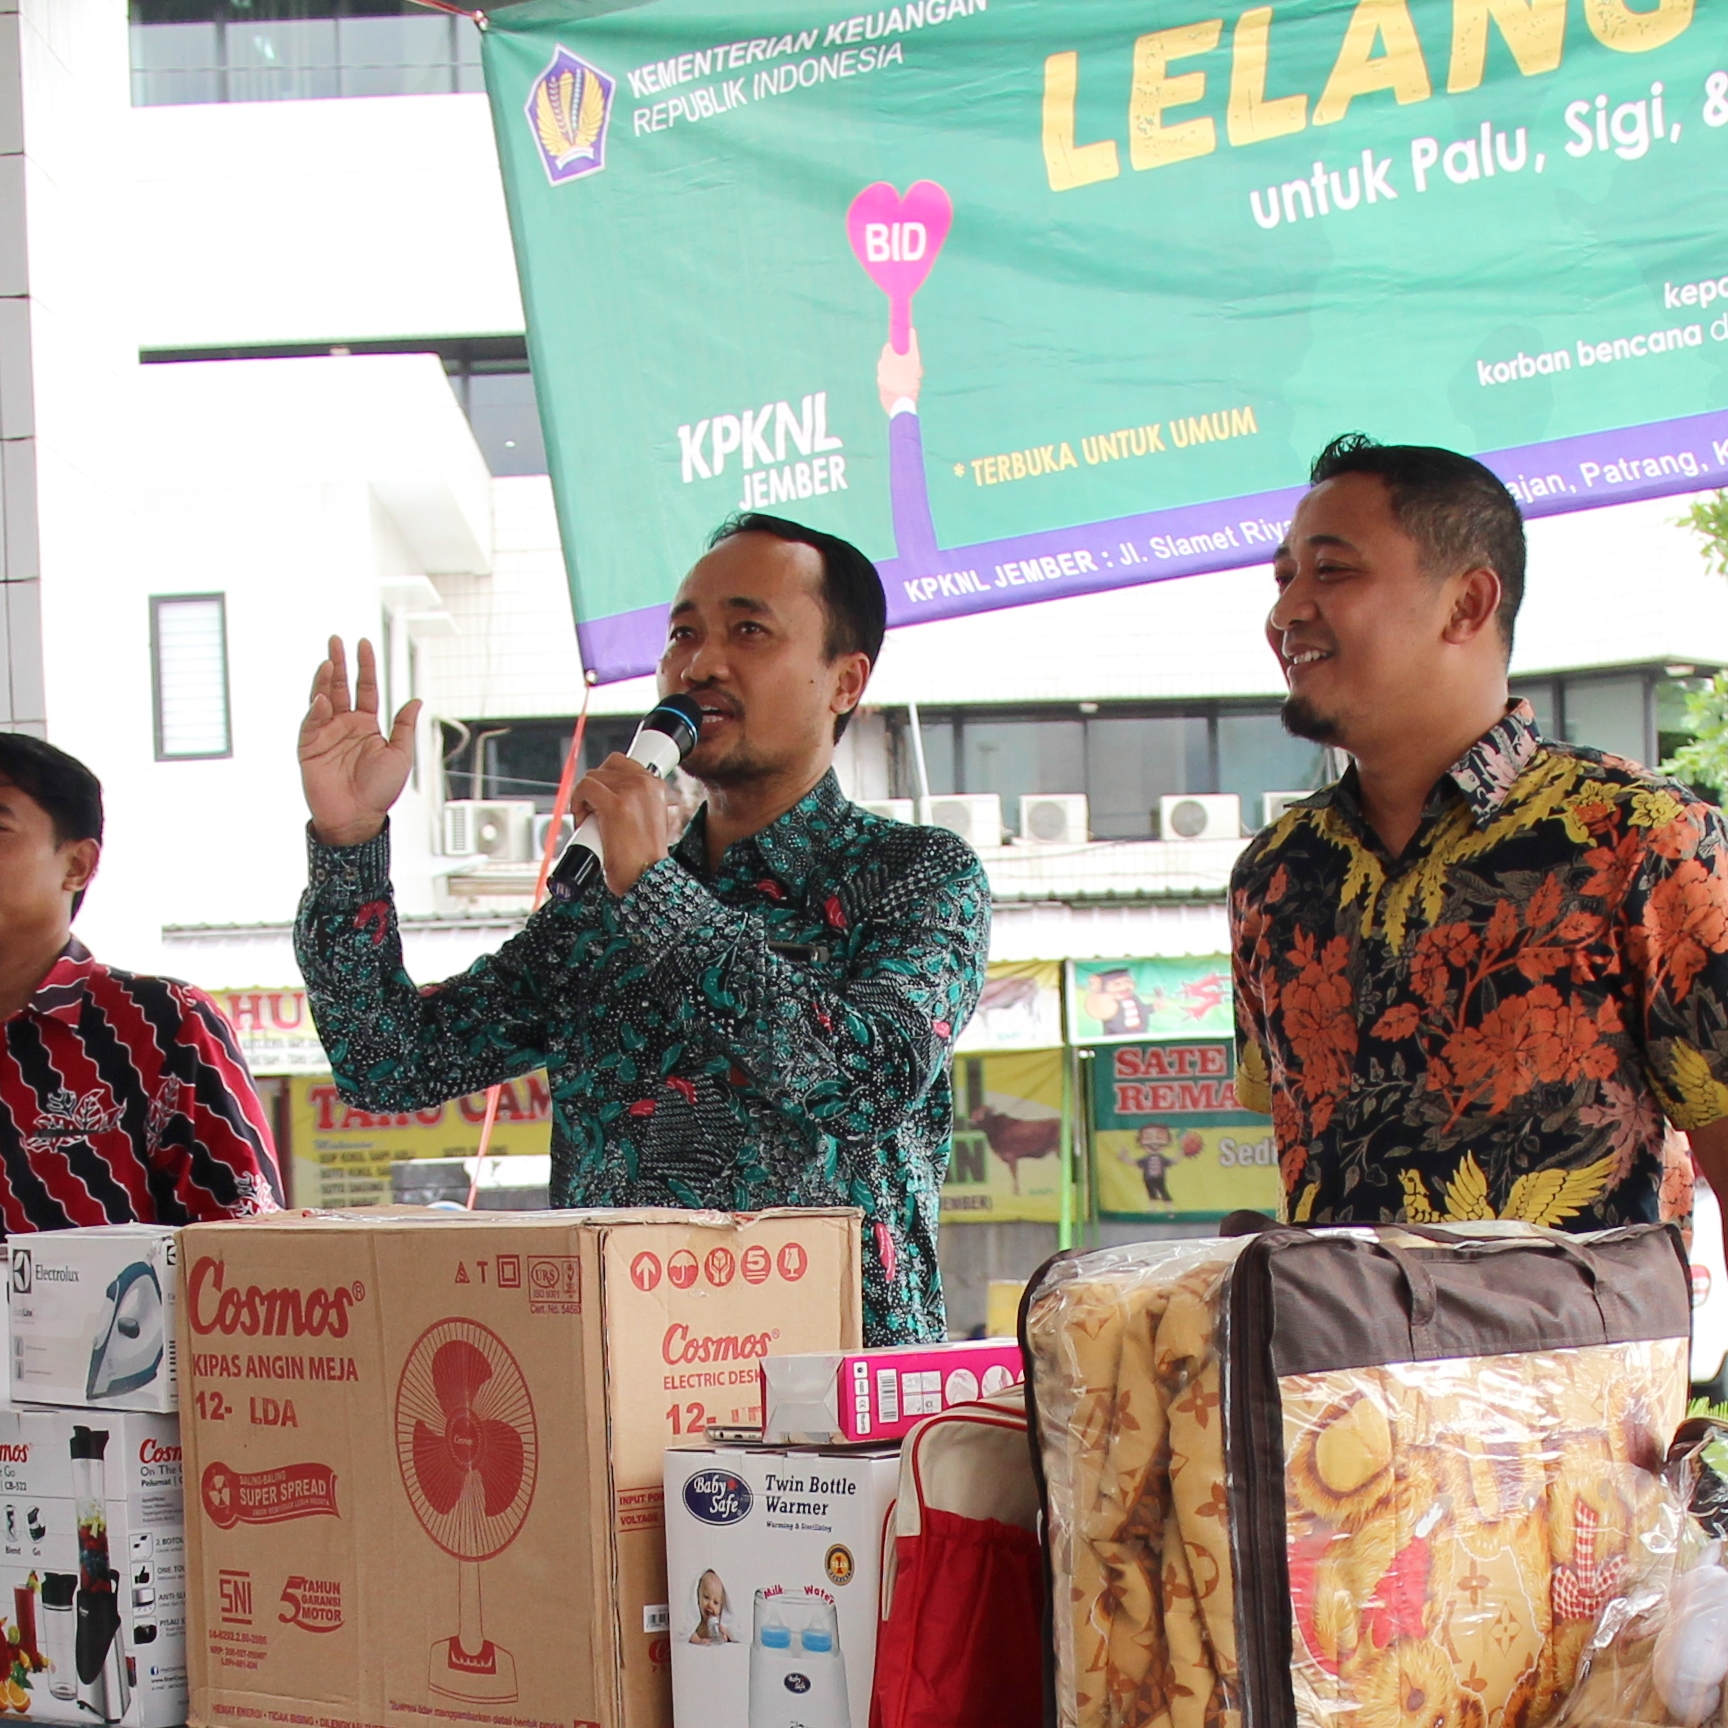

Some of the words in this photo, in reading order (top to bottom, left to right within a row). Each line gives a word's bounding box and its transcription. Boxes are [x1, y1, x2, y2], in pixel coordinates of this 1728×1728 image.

[627, 30, 818, 99] KEMENTERIAN
[633, 84, 748, 136] REPUBLIK
[753, 41, 903, 103] INDONESIA
[1249, 149, 1398, 229] untuk
[1411, 121, 1545, 193] Palu,
[1564, 82, 1681, 161] Sigi,
[865, 222, 927, 262] BID
[1477, 347, 1571, 387] korban
[1577, 322, 1703, 369] bencana
[677, 391, 844, 484] KPKNL
[971, 442, 1078, 488] TERBUKA
[1081, 420, 1166, 467] UNTUK
[1169, 405, 1258, 450] UMUM
[738, 454, 849, 512] JEMBER
[903, 568, 991, 604] KPKNL
[994, 548, 1099, 591] JEMBER
[1151, 523, 1237, 558] Slamet
[1580, 438, 1711, 501] Patrang,
[1114, 1047, 1227, 1077] SATE
[35, 1264, 80, 1283] Electrolux
[186, 1255, 355, 1339] Cosmos
[661, 1322, 772, 1366] Cosmos
[192, 1353, 242, 1379] KIPAS
[246, 1354, 305, 1381] ANGIN
[308, 1356, 359, 1383] MEJA
[663, 1371, 726, 1391] ELECTRIC
[249, 1396, 299, 1429] LDA
[239, 1487, 278, 1507] SUPER
[280, 1479, 327, 1504] SPREAD
[693, 1474, 727, 1498] Baby
[765, 1474, 804, 1492] Twin
[809, 1476, 857, 1495] Bottle
[709, 1494, 739, 1518] Safe
[765, 1496, 829, 1516] Warmer
[219, 1578, 253, 1615] SNI
[278, 1575, 306, 1624] 5
[302, 1578, 341, 1595] TAHUN
[301, 1594, 341, 1607] GARANSI
[763, 1584, 784, 1599] Milk
[804, 1584, 836, 1606] Water
[302, 1607, 342, 1622] MOTOR
